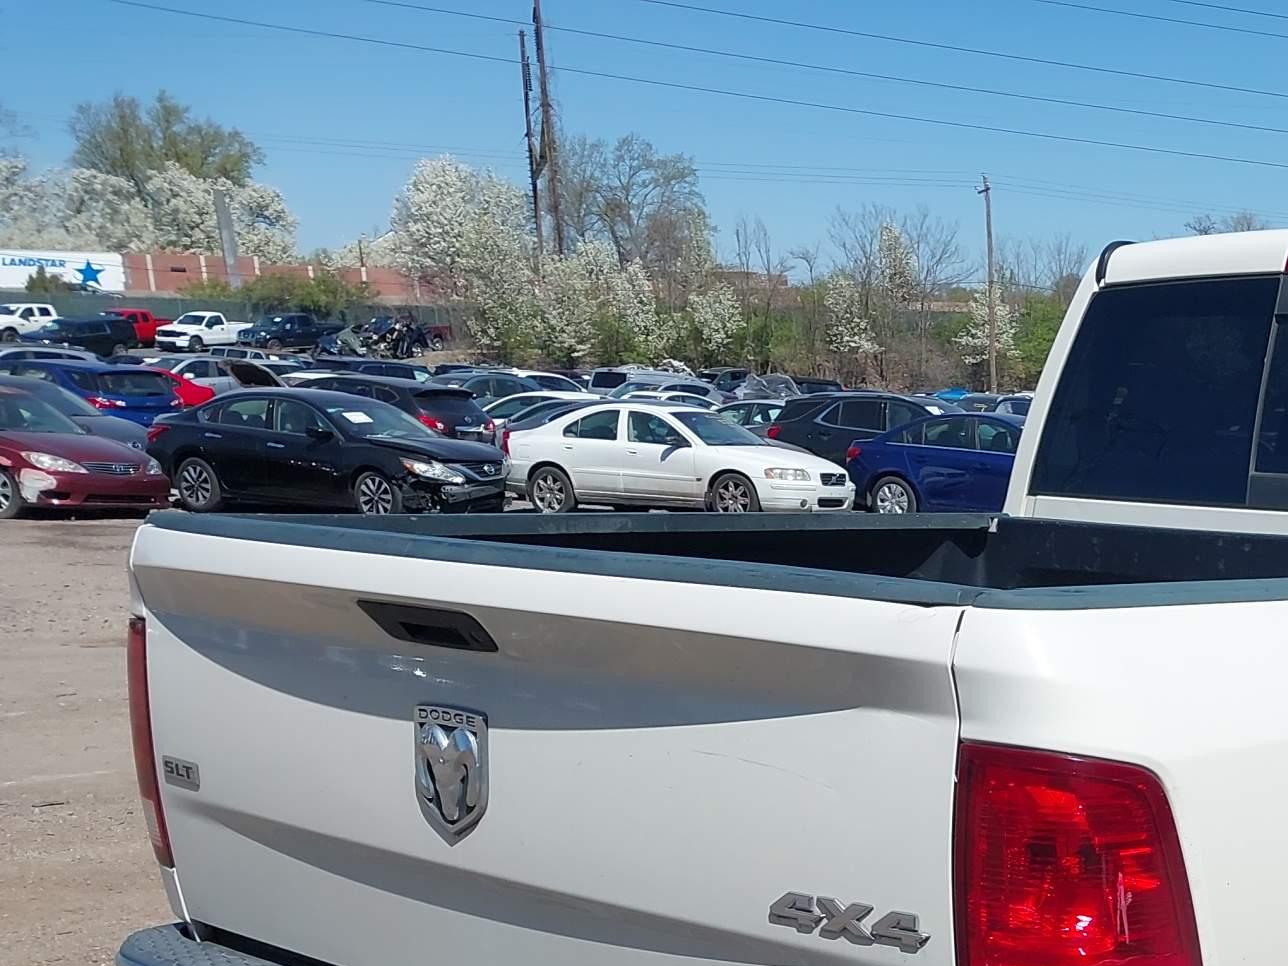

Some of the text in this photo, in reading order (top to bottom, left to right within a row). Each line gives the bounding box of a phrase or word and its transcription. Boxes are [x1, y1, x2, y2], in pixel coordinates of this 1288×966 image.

[1, 257, 66, 268] LANDSTAR
[417, 707, 477, 728] DODGE
[163, 760, 194, 780] SLT
[768, 891, 931, 954] 4X4
